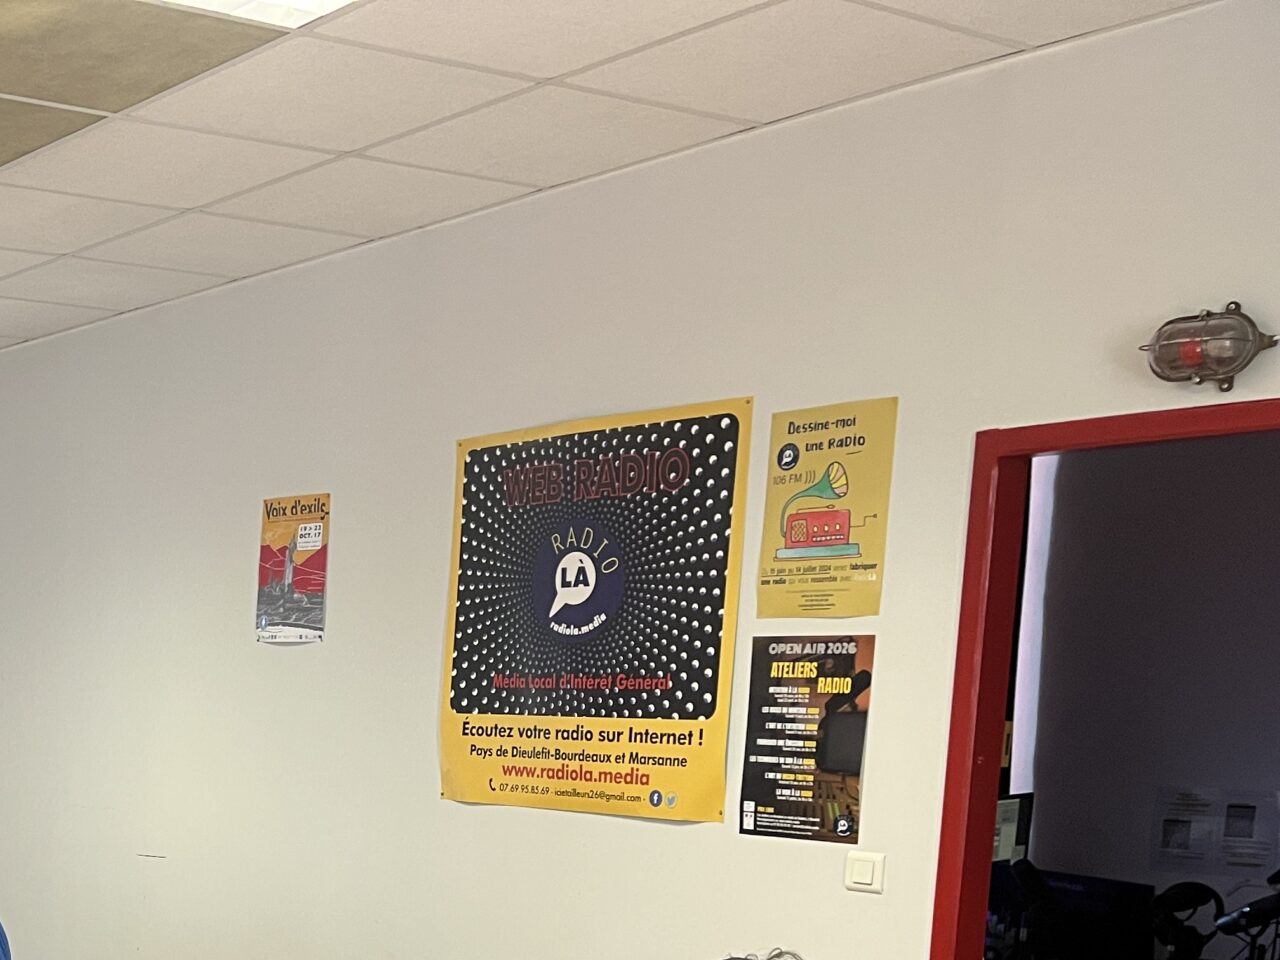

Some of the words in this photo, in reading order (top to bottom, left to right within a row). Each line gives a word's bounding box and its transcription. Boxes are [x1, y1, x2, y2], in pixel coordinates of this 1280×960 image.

[788, 416, 856, 435] Dessine-moi
[806, 442, 823, 452] une
[504, 463, 564, 506] WEB
[573, 448, 690, 500] RADIO
[789, 474, 802, 483] FM
[265, 501, 287, 520] Voix
[551, 526, 619, 573] RADIO
[561, 559, 590, 588] LÀ
[550, 613, 606, 635] radiola.media
[769, 643, 802, 654] OPEN
[803, 643, 826, 654] AIR
[770, 662, 818, 678] ATELIERS
[529, 673, 556, 688] Local
[617, 672, 671, 689] Général
[817, 677, 852, 694] RADIO
[462, 716, 514, 738] Écoutez
[518, 725, 551, 739] votre
[555, 725, 594, 741] radio
[598, 730, 624, 742] sur
[628, 727, 693, 745] Internet
[699, 729, 703, 746] !
[470, 744, 493, 759] Pays
[496, 745, 508, 758] de
[512, 746, 612, 763] Dieulefit-Bourdeaux
[615, 753, 625, 764] et
[629, 752, 687, 767] Marsanne
[502, 763, 650, 786] www.radiola.media
[500, 783, 550, 795] 07.69.95.85.69
